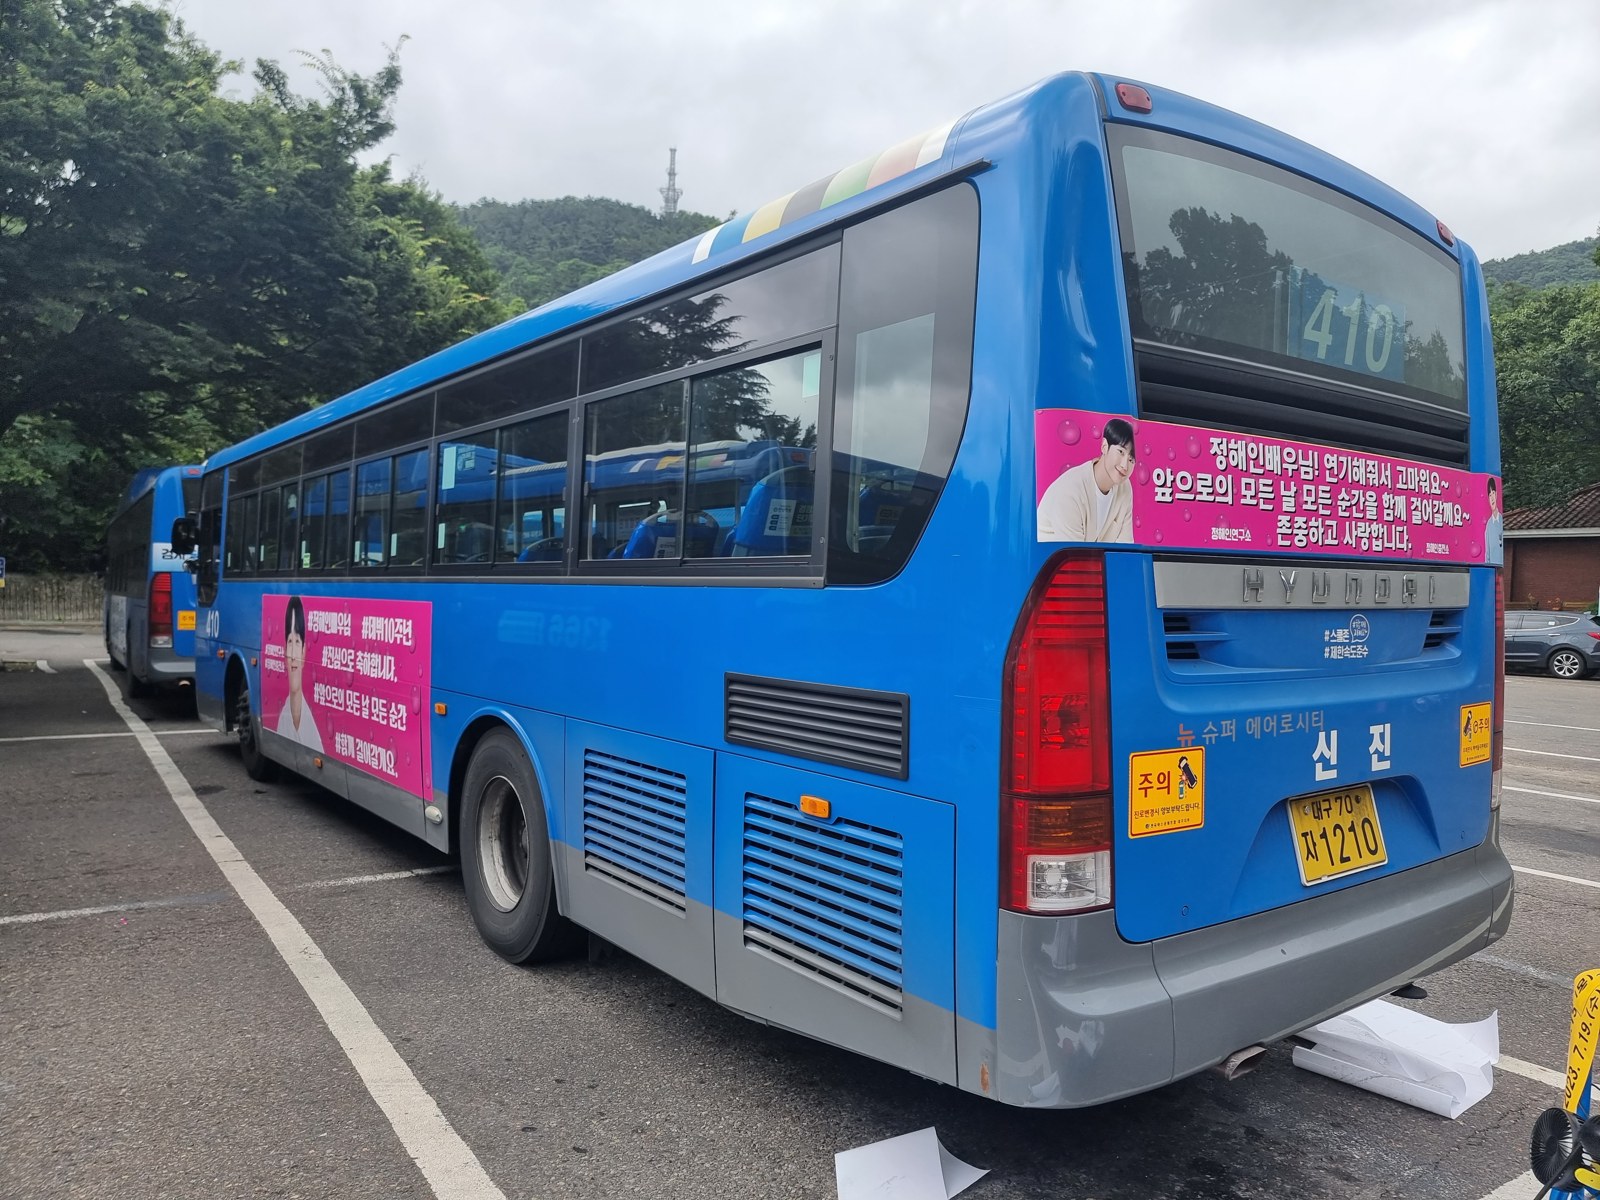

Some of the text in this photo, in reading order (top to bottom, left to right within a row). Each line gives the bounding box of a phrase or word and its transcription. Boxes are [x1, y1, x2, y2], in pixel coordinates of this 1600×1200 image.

[1303, 288, 1393, 373] 410
[1209, 437, 1449, 496] 정해인배우님! 연기해줘서 고마워요~
[1152, 467, 1233, 506] 앞으로의
[1240, 477, 1274, 511] 모든
[1280, 481, 1297, 513] 날
[1302, 485, 1333, 517] 모든
[1337, 487, 1378, 520] 순간을
[1382, 492, 1406, 522] 함께
[1211, 527, 1252, 542] 정해인연구소
[1276, 515, 1412, 553] 존중하고 사랑합니다.
[1243, 567, 1436, 604] HYUNDAI
[206, 610, 220, 639] 410
[361, 615, 413, 647] #데뷔10주년
[1324, 629, 1350, 643] #스쿨존
[322, 645, 355, 673] #진심으로
[1324, 645, 1369, 659] #제한속도준수
[314, 682, 407, 732] #앞으로의 모든 날 모든 순간
[1177, 710, 1325, 747] 뉴 슈퍼 에어로시티
[335, 732, 355, 759] #함께
[1138, 771, 1171, 798] 주의
[1311, 795, 1353, 821] 대구 70
